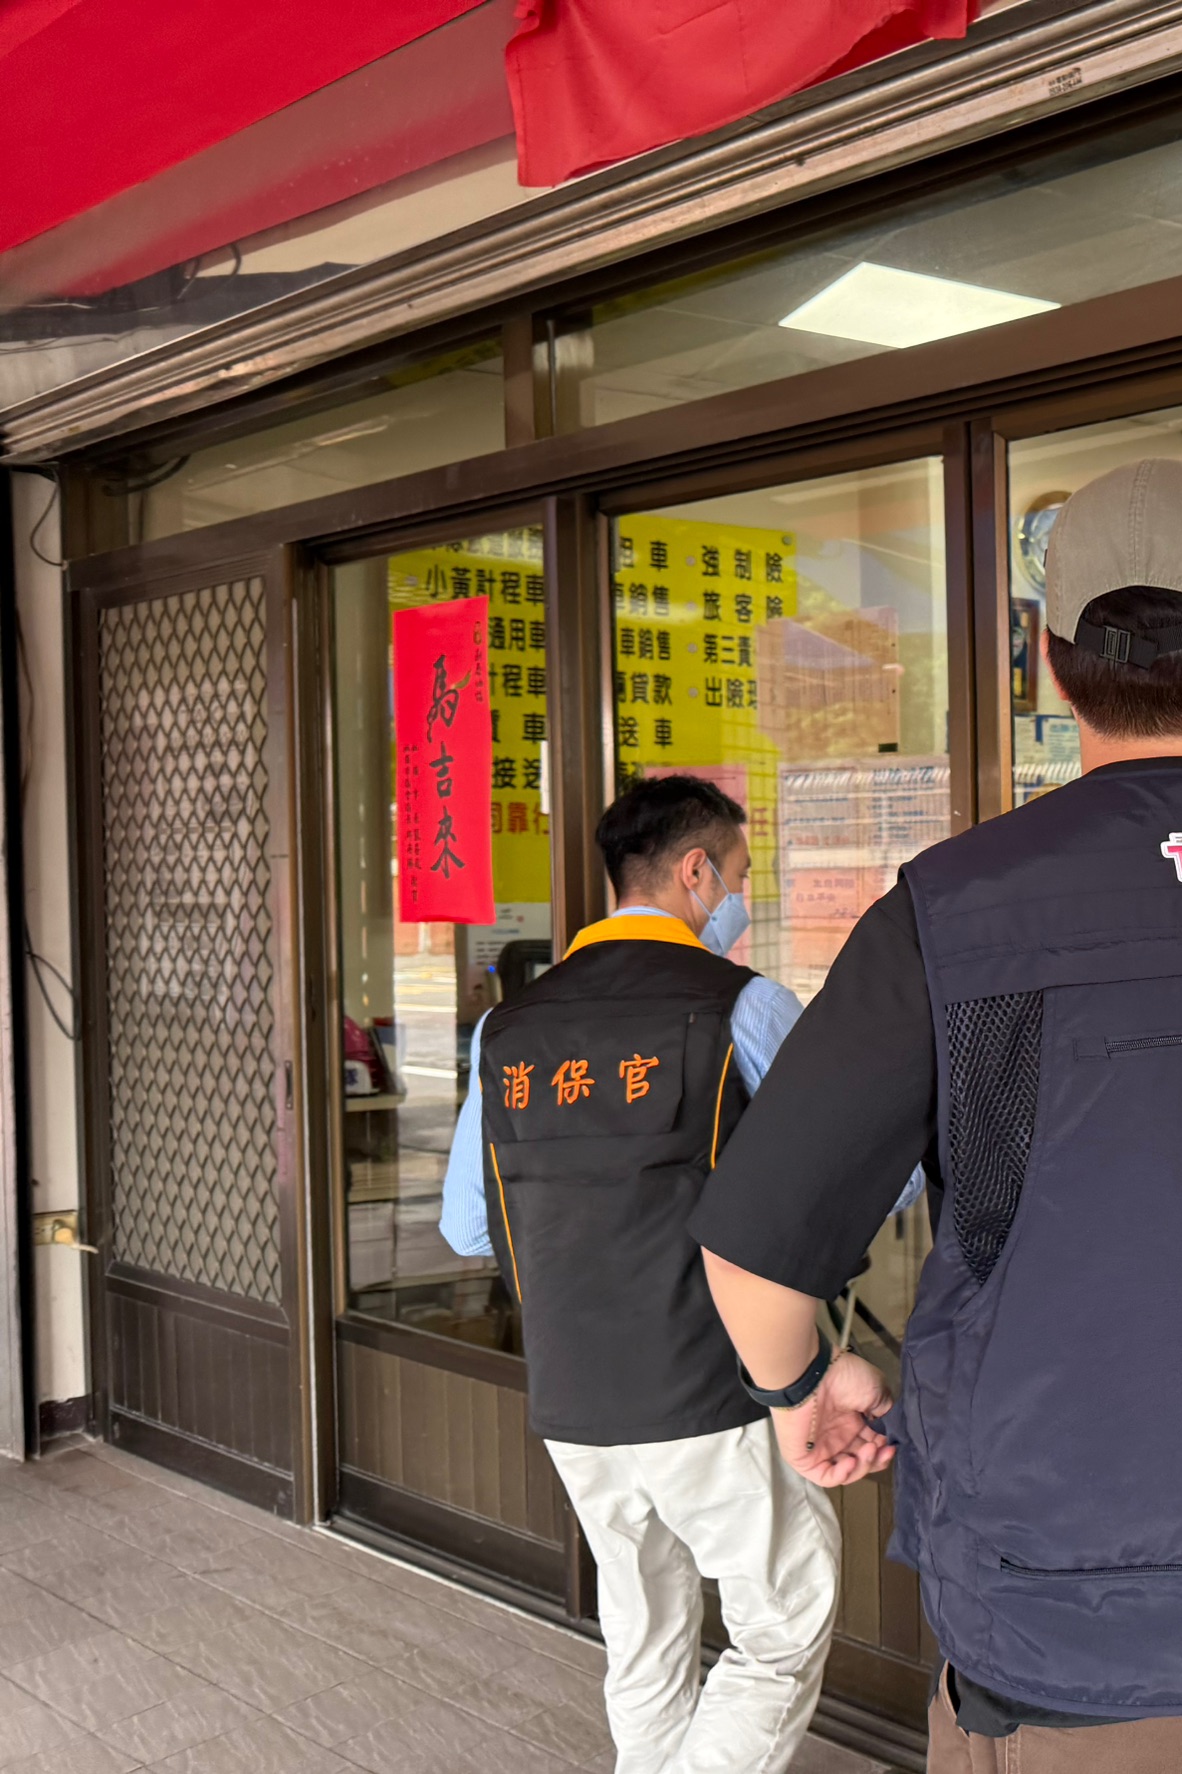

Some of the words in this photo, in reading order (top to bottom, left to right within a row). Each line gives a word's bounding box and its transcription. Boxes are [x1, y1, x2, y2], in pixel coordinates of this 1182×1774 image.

[701, 545, 784, 584] 強制險
[502, 1053, 660, 1111] 消保官
